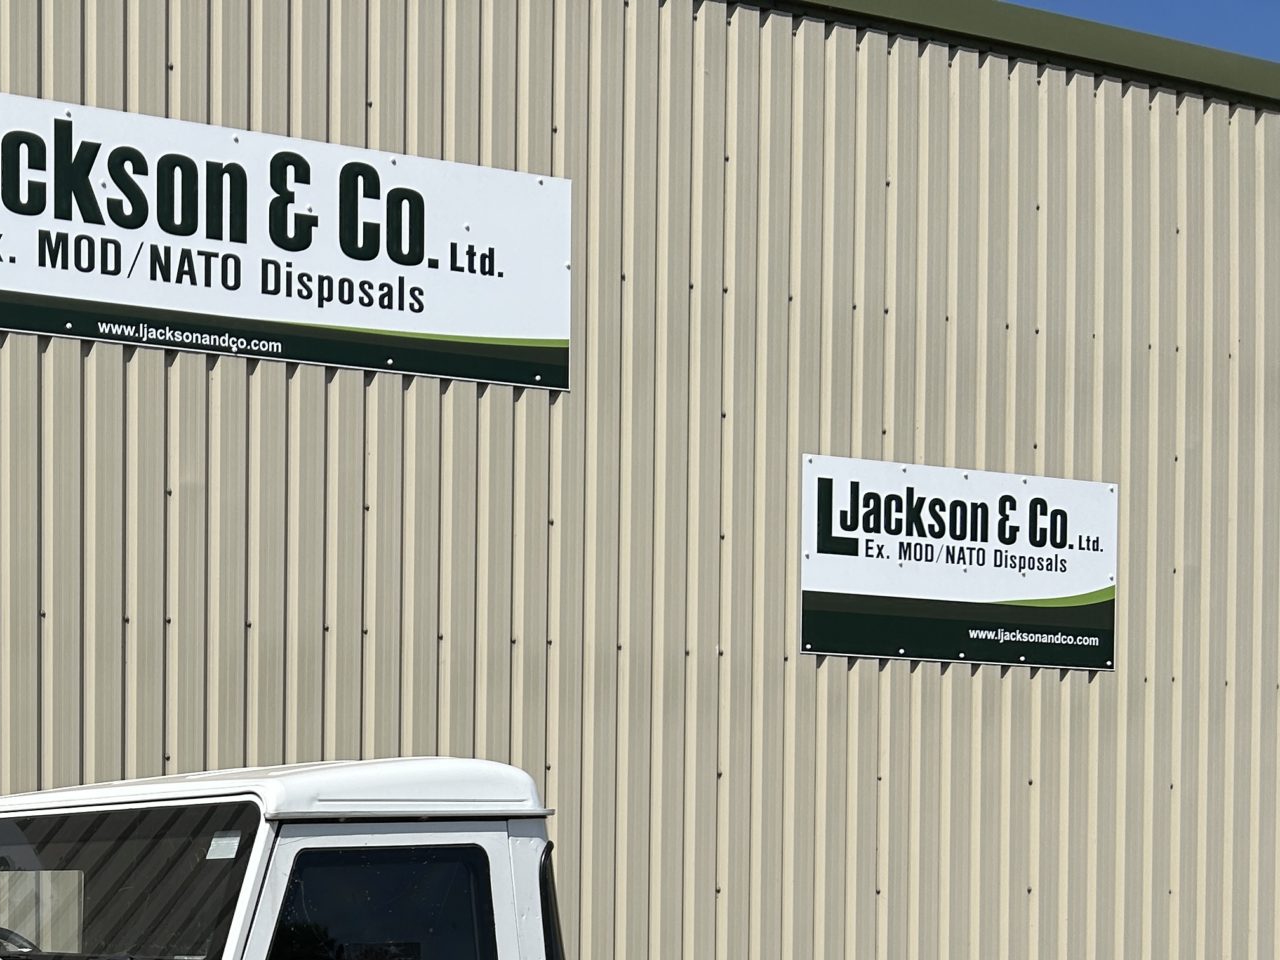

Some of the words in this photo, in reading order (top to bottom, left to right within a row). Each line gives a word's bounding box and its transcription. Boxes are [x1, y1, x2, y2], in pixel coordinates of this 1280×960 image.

[269, 152, 319, 253] &
[339, 162, 439, 270] Co.
[451, 243, 504, 278] Ltd.
[39, 230, 241, 291] MOD/NATO
[262, 259, 425, 314] Disposals
[97, 321, 282, 354] www.ljacksonandco.com
[998, 495, 1020, 546] &
[1029, 498, 1074, 550] Co.
[1079, 535, 1104, 552] Ltd.
[865, 539, 890, 560] Ex.
[899, 542, 986, 567] MOD/NATO
[994, 550, 1067, 573] Disposals
[969, 627, 1099, 646] www.ljacksonandco.com
